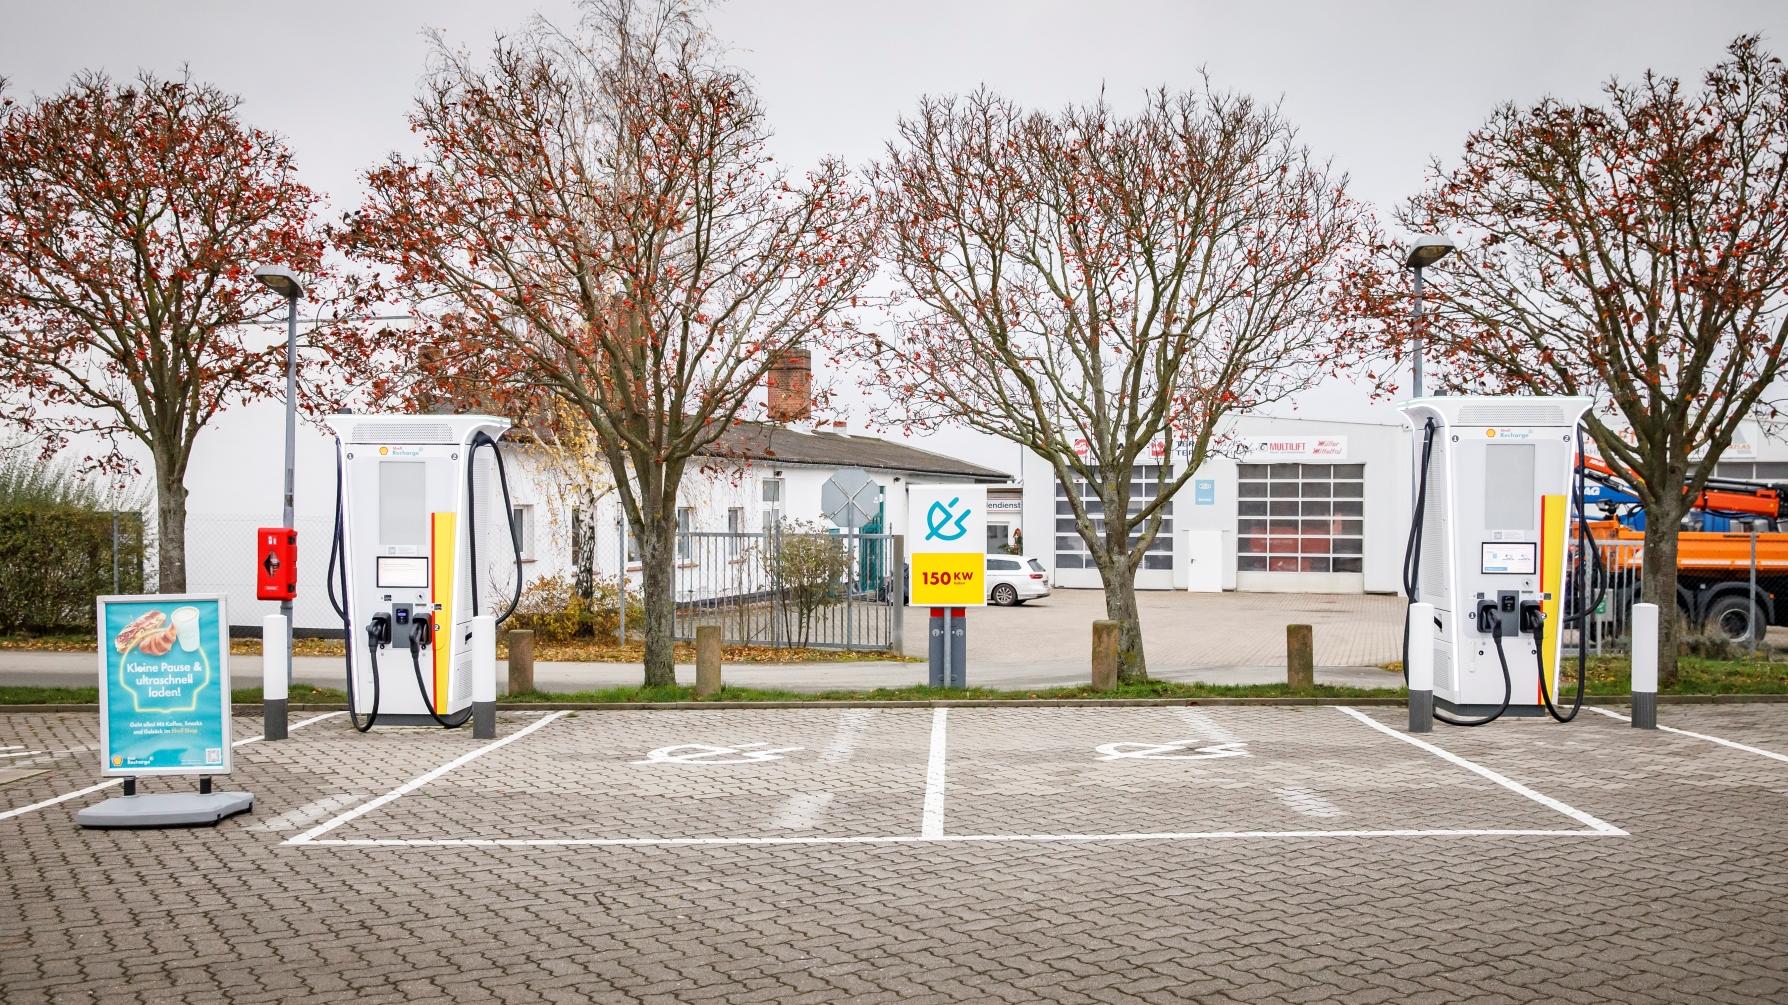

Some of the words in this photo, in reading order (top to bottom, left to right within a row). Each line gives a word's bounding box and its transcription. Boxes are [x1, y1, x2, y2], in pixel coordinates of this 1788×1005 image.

[1270, 442, 1305, 451] MULTILIFT
[922, 572, 951, 585] 150
[126, 662, 158, 672] Kleine
[161, 662, 190, 672] Pause
[193, 662, 202, 671] &
[136, 674, 193, 685] ultraschnell
[148, 687, 181, 697] laden!
